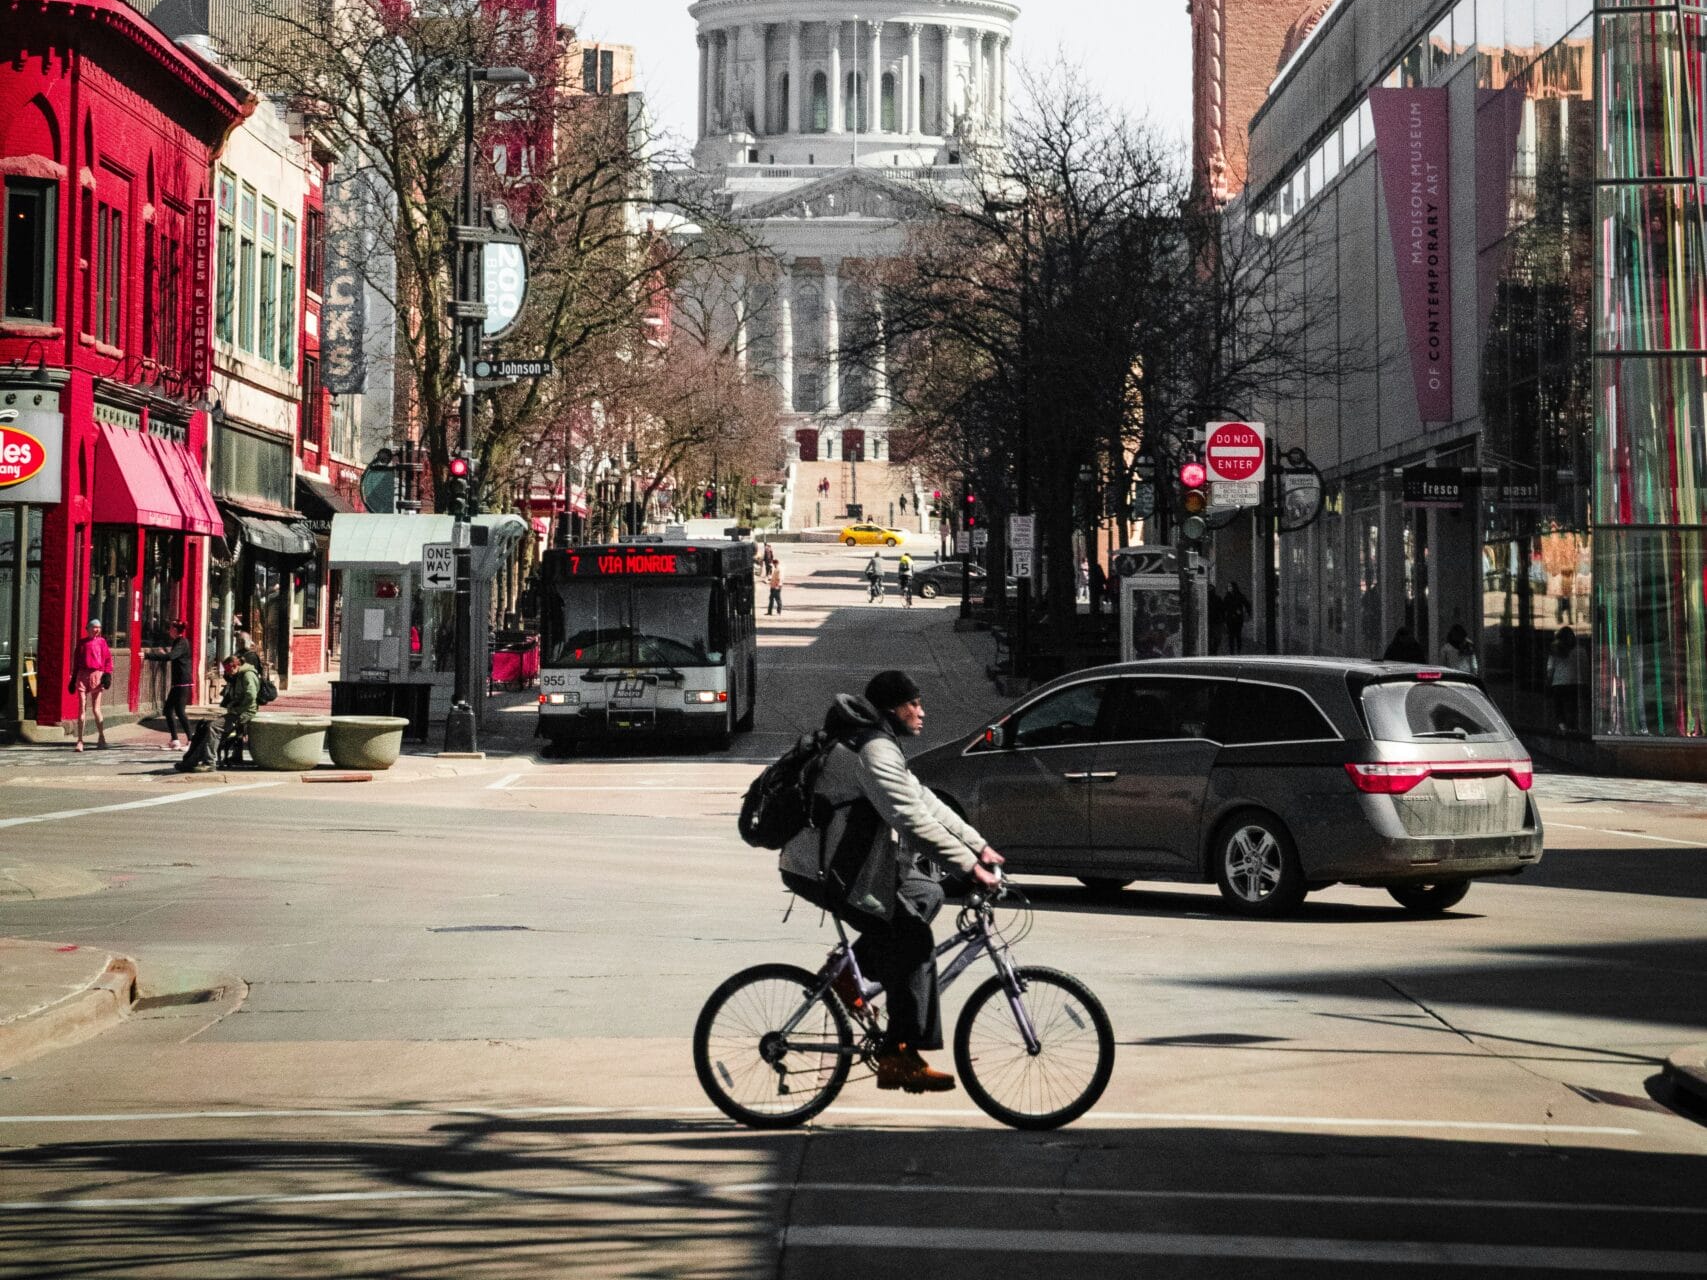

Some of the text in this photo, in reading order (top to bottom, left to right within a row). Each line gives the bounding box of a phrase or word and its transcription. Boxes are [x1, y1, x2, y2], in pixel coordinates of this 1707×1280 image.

[1410, 103, 1422, 263] MADISON MUSEUM
[196, 205, 207, 280] NOODLES
[499, 243, 519, 318] 200
[1427, 163, 1440, 390] OF CONTEMPORARY ART
[487, 258, 498, 316] BLOCK
[194, 305, 206, 378] COMPANY
[499, 362, 541, 375] Johnson
[1217, 435, 1254, 443] DO NOT
[1218, 460, 1253, 469] ENTER
[1423, 482, 1459, 495] fresco
[427, 548, 451, 559] ONE
[426, 561, 452, 572] WAY
[570, 555, 678, 574] 7 VIA MONROE
[1016, 563, 1029, 575] 15
[543, 675, 565, 686] 955
